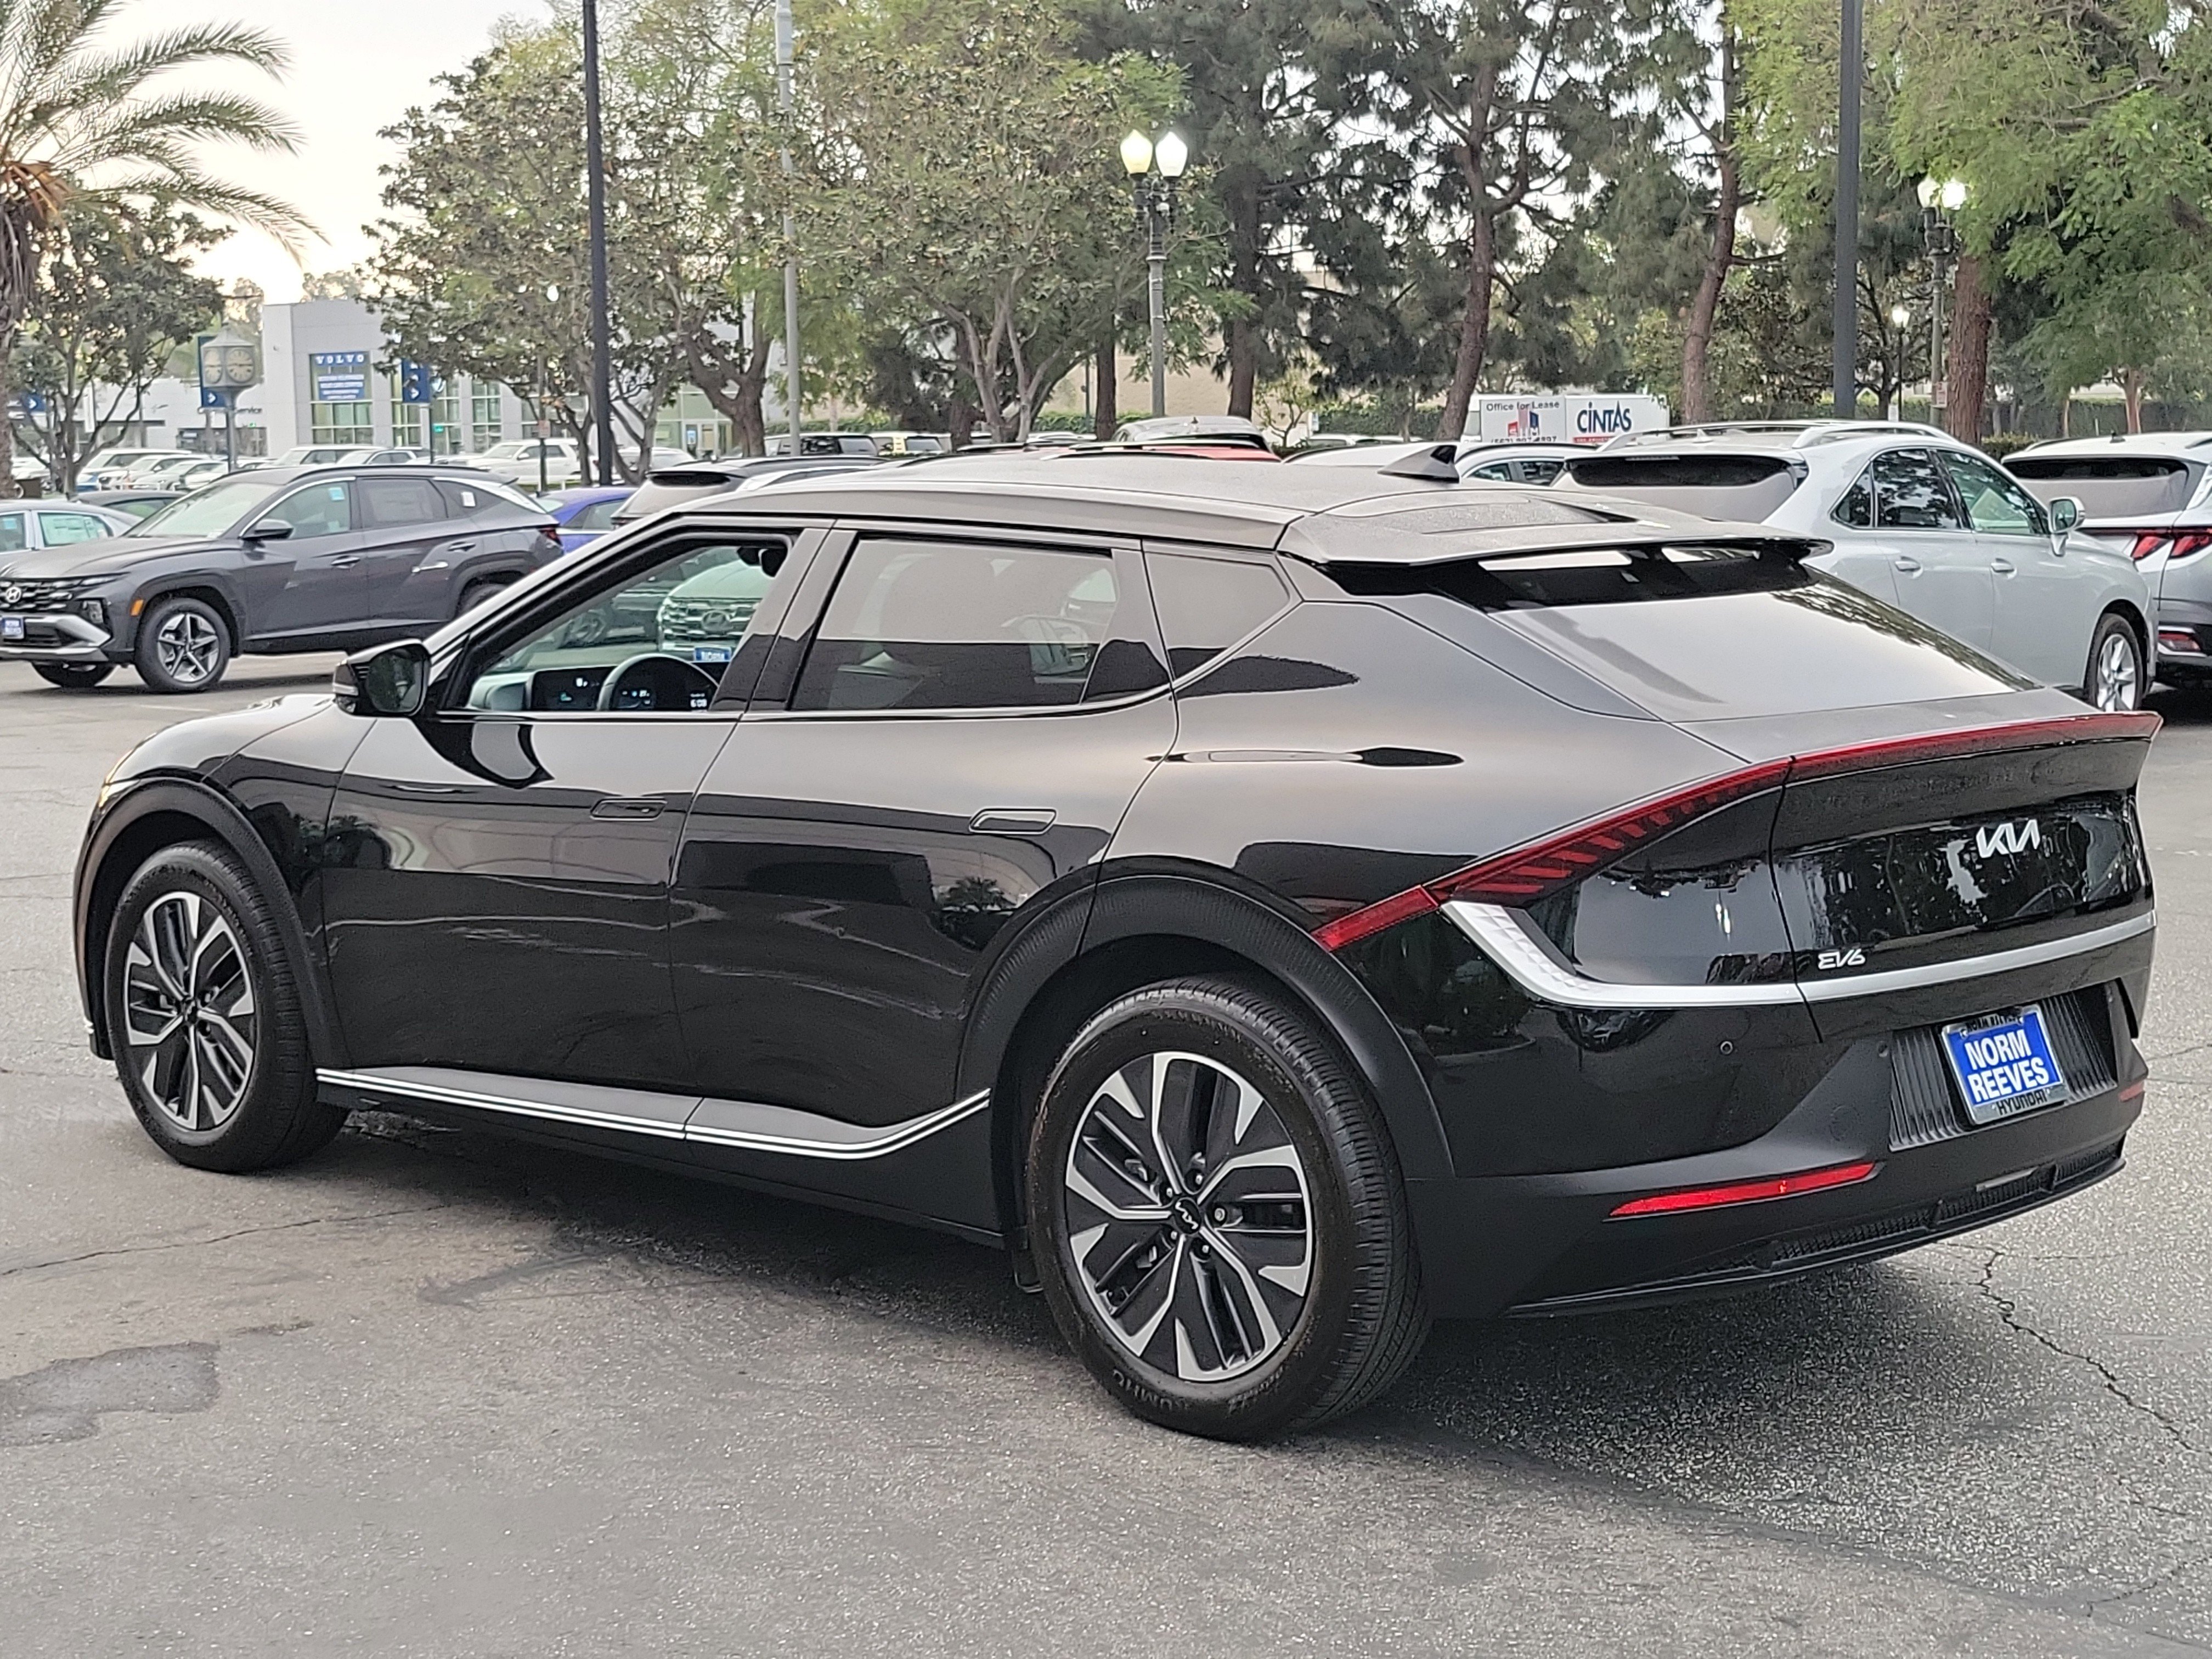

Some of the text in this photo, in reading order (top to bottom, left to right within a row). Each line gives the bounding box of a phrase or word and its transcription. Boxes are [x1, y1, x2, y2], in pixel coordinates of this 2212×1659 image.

[315, 354, 364, 364] VOLVO
[1486, 401, 1560, 411] Office for Lease
[1976, 819, 2040, 859] KIA
[1818, 948, 1866, 970] EV6
[1964, 1029, 2032, 1070] NORM
[1967, 1057, 2049, 1103] REEVES
[1996, 1088, 2048, 1116] HYUNDAI
